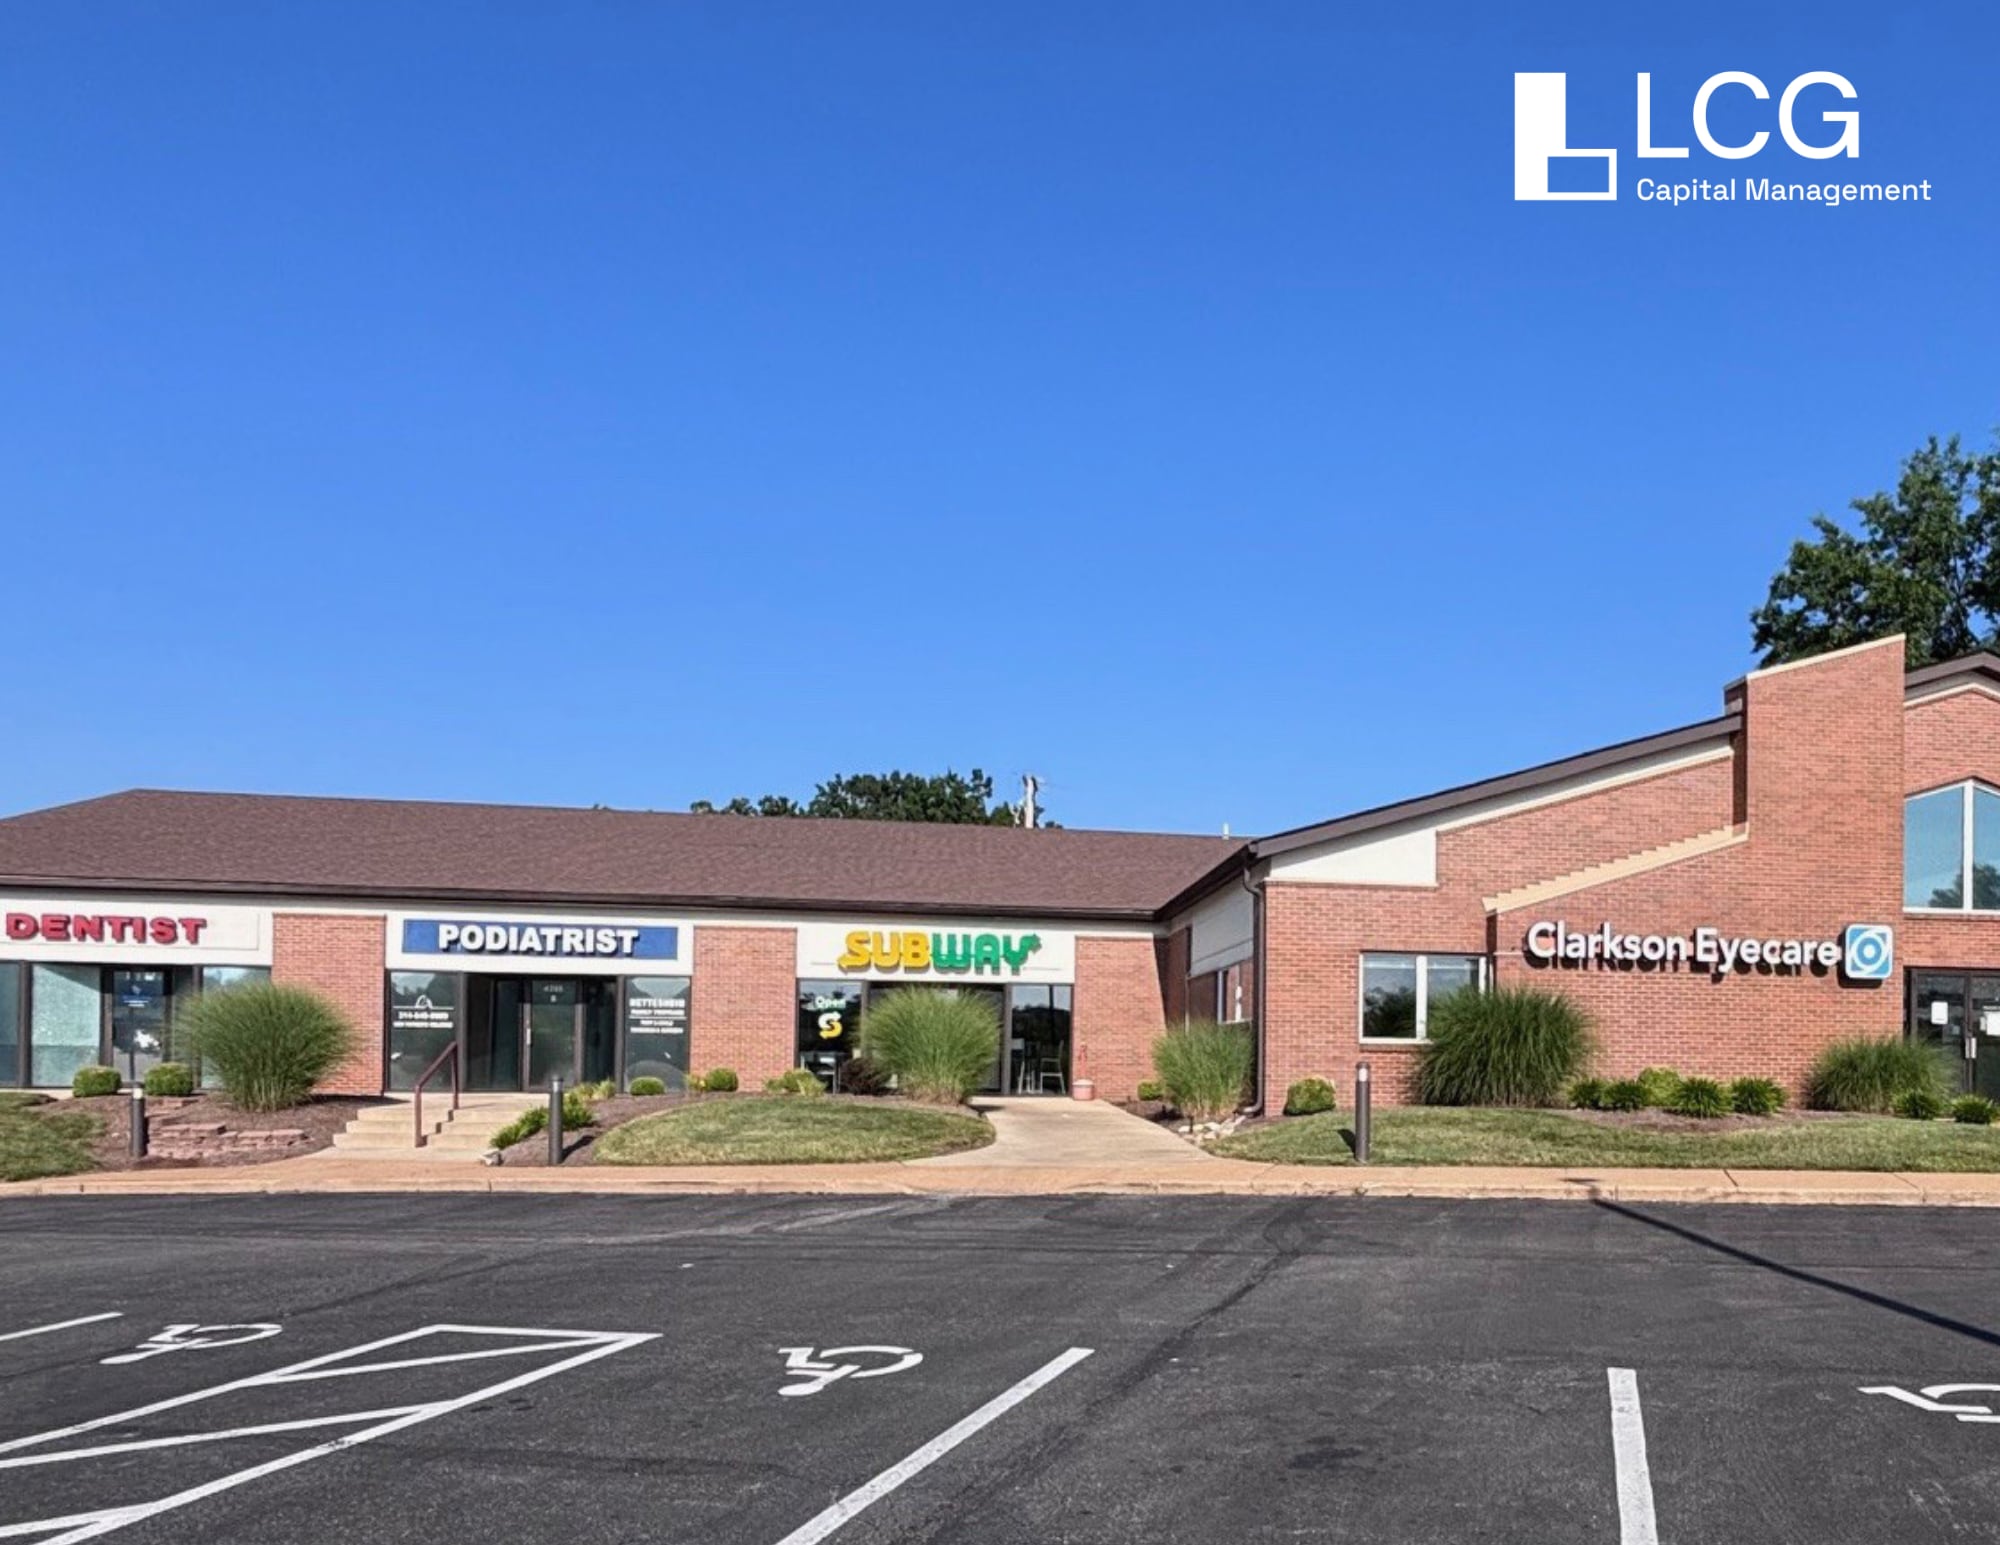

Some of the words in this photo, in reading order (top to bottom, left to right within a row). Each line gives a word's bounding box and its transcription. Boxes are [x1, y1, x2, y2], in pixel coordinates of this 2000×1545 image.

[6, 913, 207, 944] DENTIST
[438, 923, 640, 955] PODIATRIST
[837, 930, 1042, 974] SUBWAY
[1526, 920, 1688, 961] Clarkson
[1694, 926, 1843, 973] Eyecare
[815, 996, 847, 1011] Open
